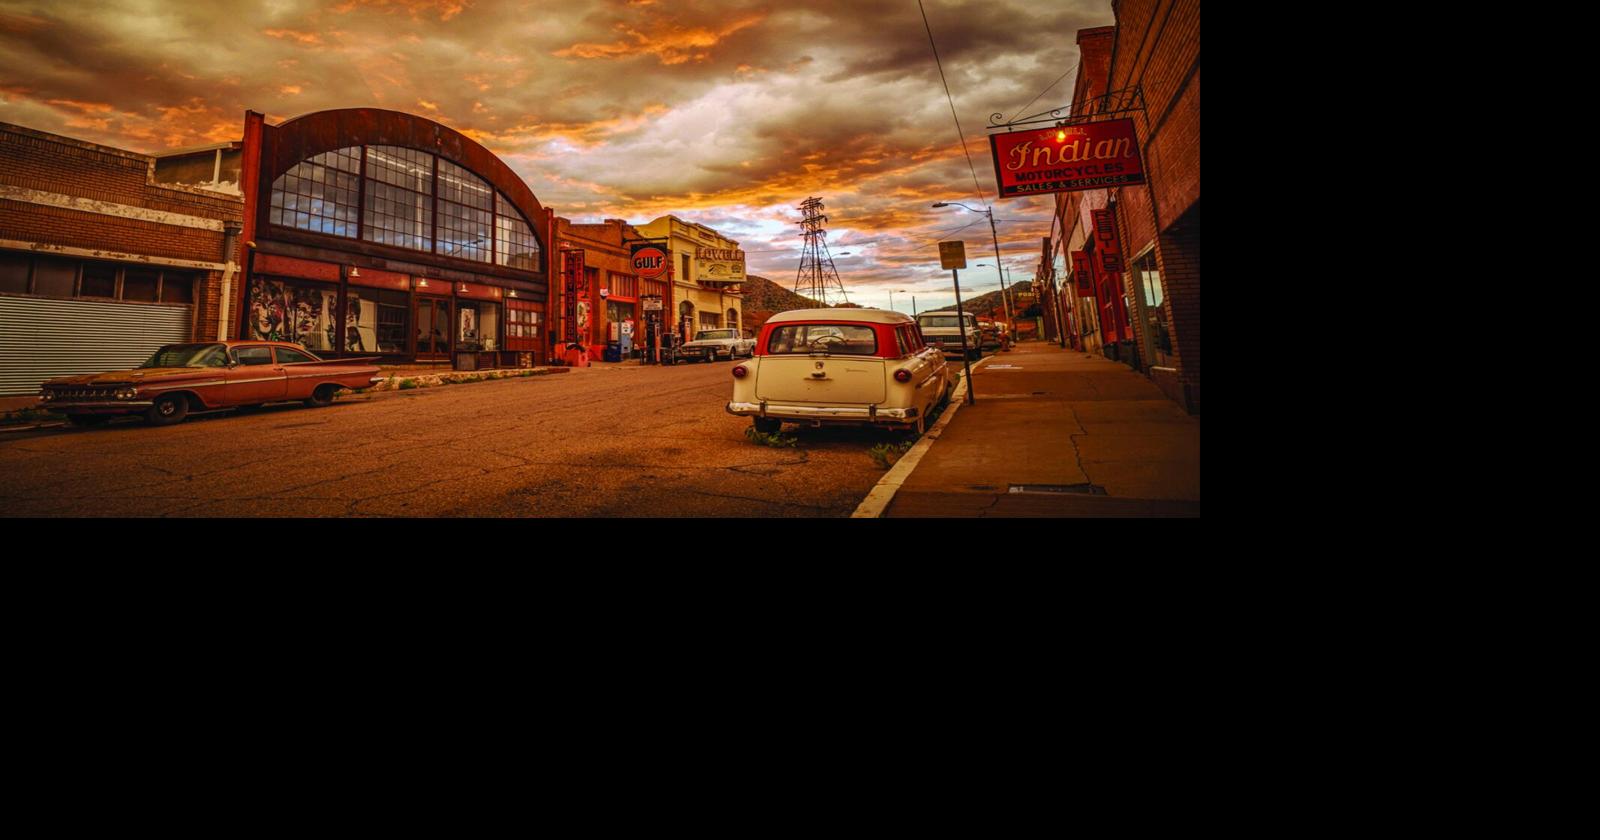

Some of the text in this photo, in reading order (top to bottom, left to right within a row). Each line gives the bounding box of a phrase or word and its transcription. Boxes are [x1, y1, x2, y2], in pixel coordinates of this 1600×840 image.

[1006, 137, 1136, 170] Indian
[1014, 163, 1125, 182] MOTORCYCLES
[1016, 174, 1129, 193] SALES & SERVICES
[634, 257, 664, 269] GULF
[695, 248, 745, 261] LOWELL
